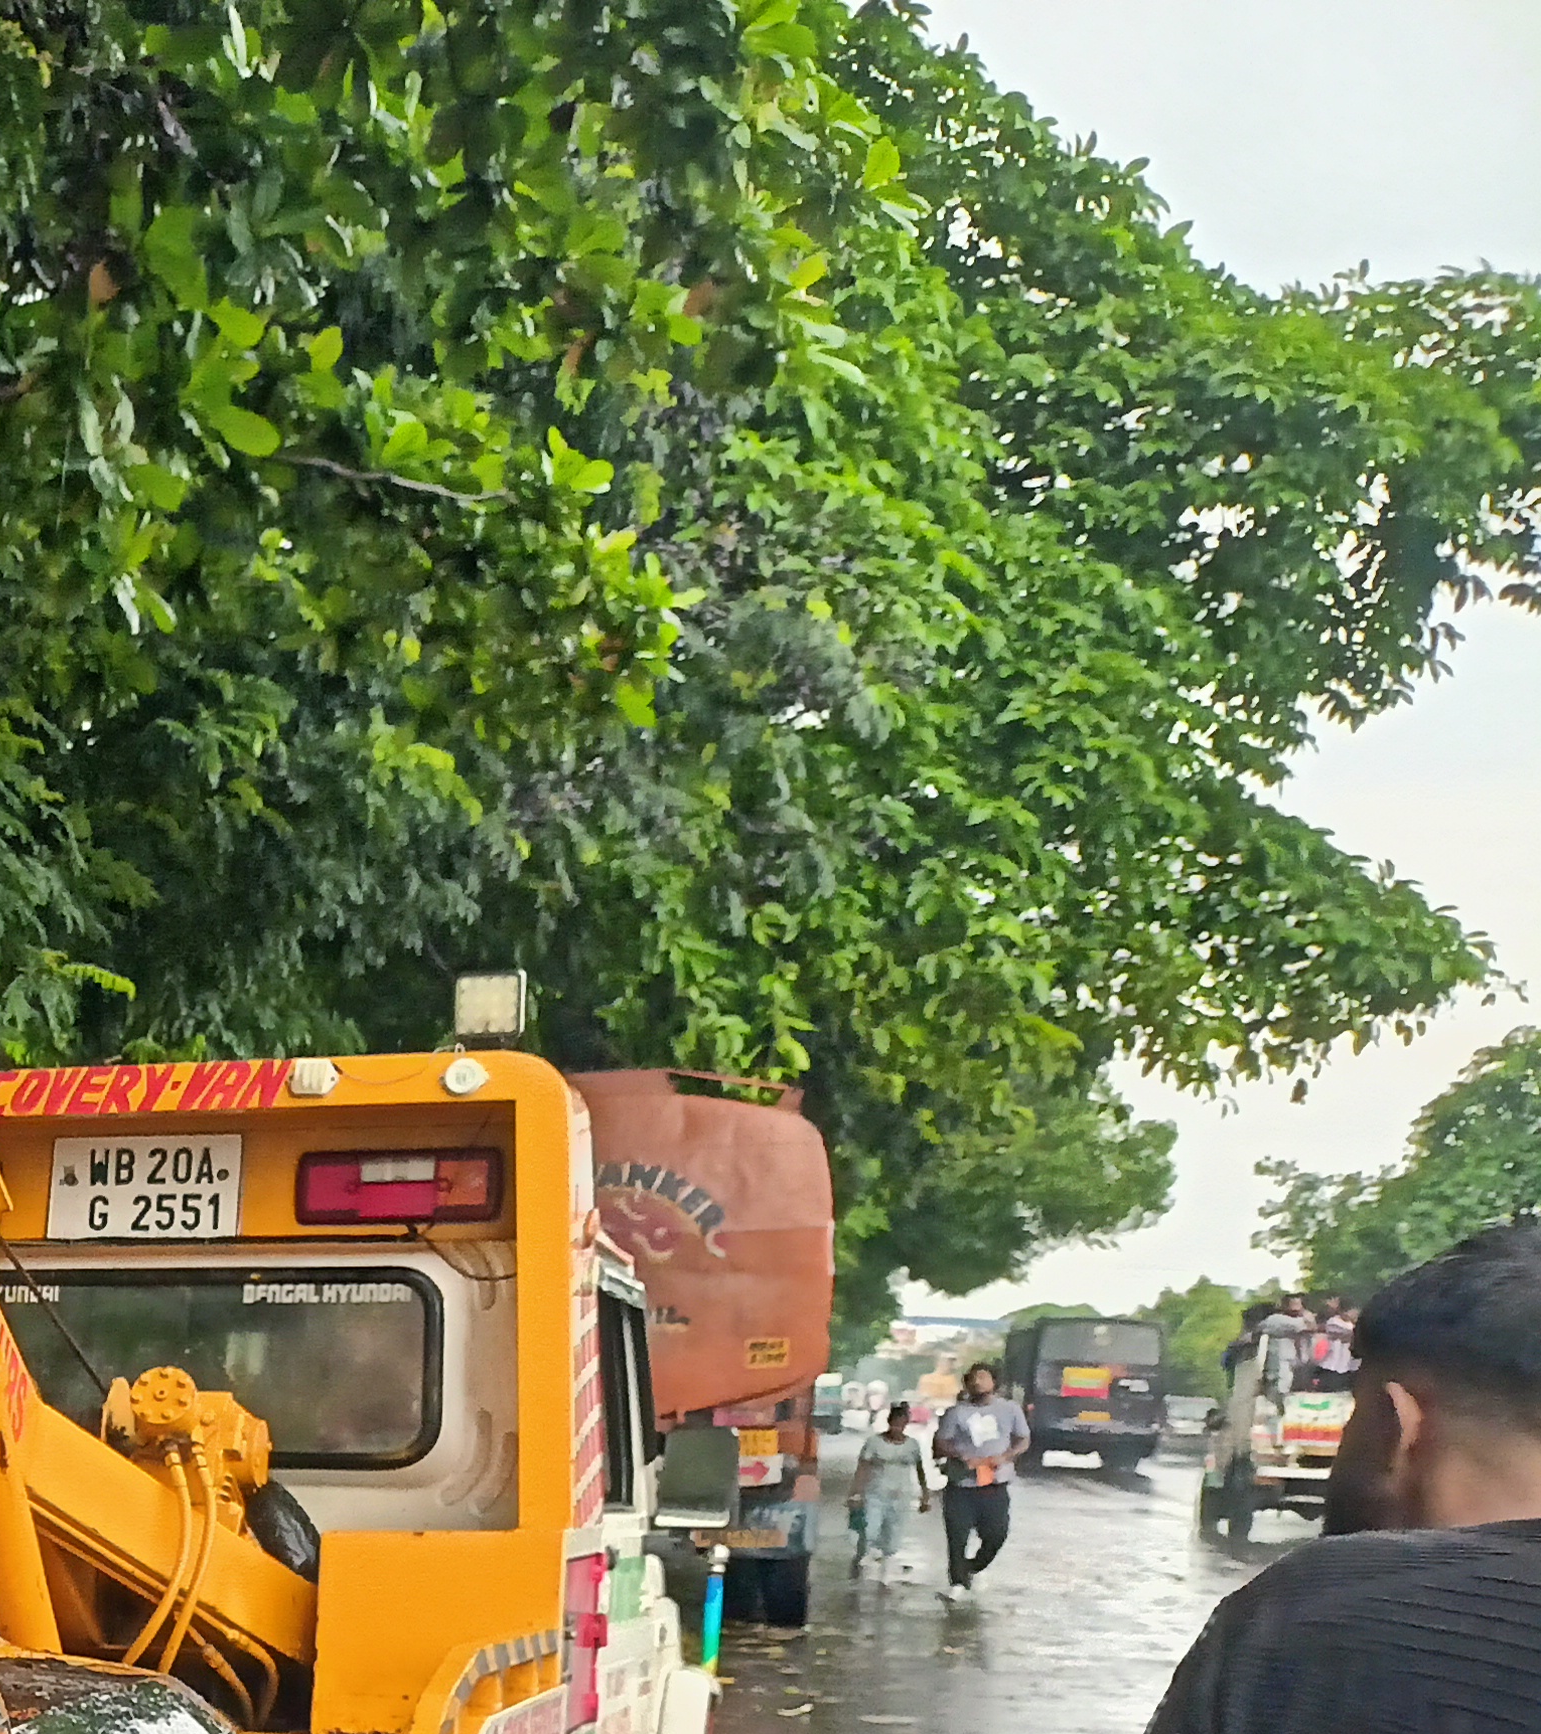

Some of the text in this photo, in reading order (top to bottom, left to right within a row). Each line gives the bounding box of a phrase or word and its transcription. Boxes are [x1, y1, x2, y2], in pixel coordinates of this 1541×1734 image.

[89, 1146, 214, 1186] WB 20A
[88, 1192, 220, 1232] G 2551
[322, 1282, 413, 1303] HYUNDAI
